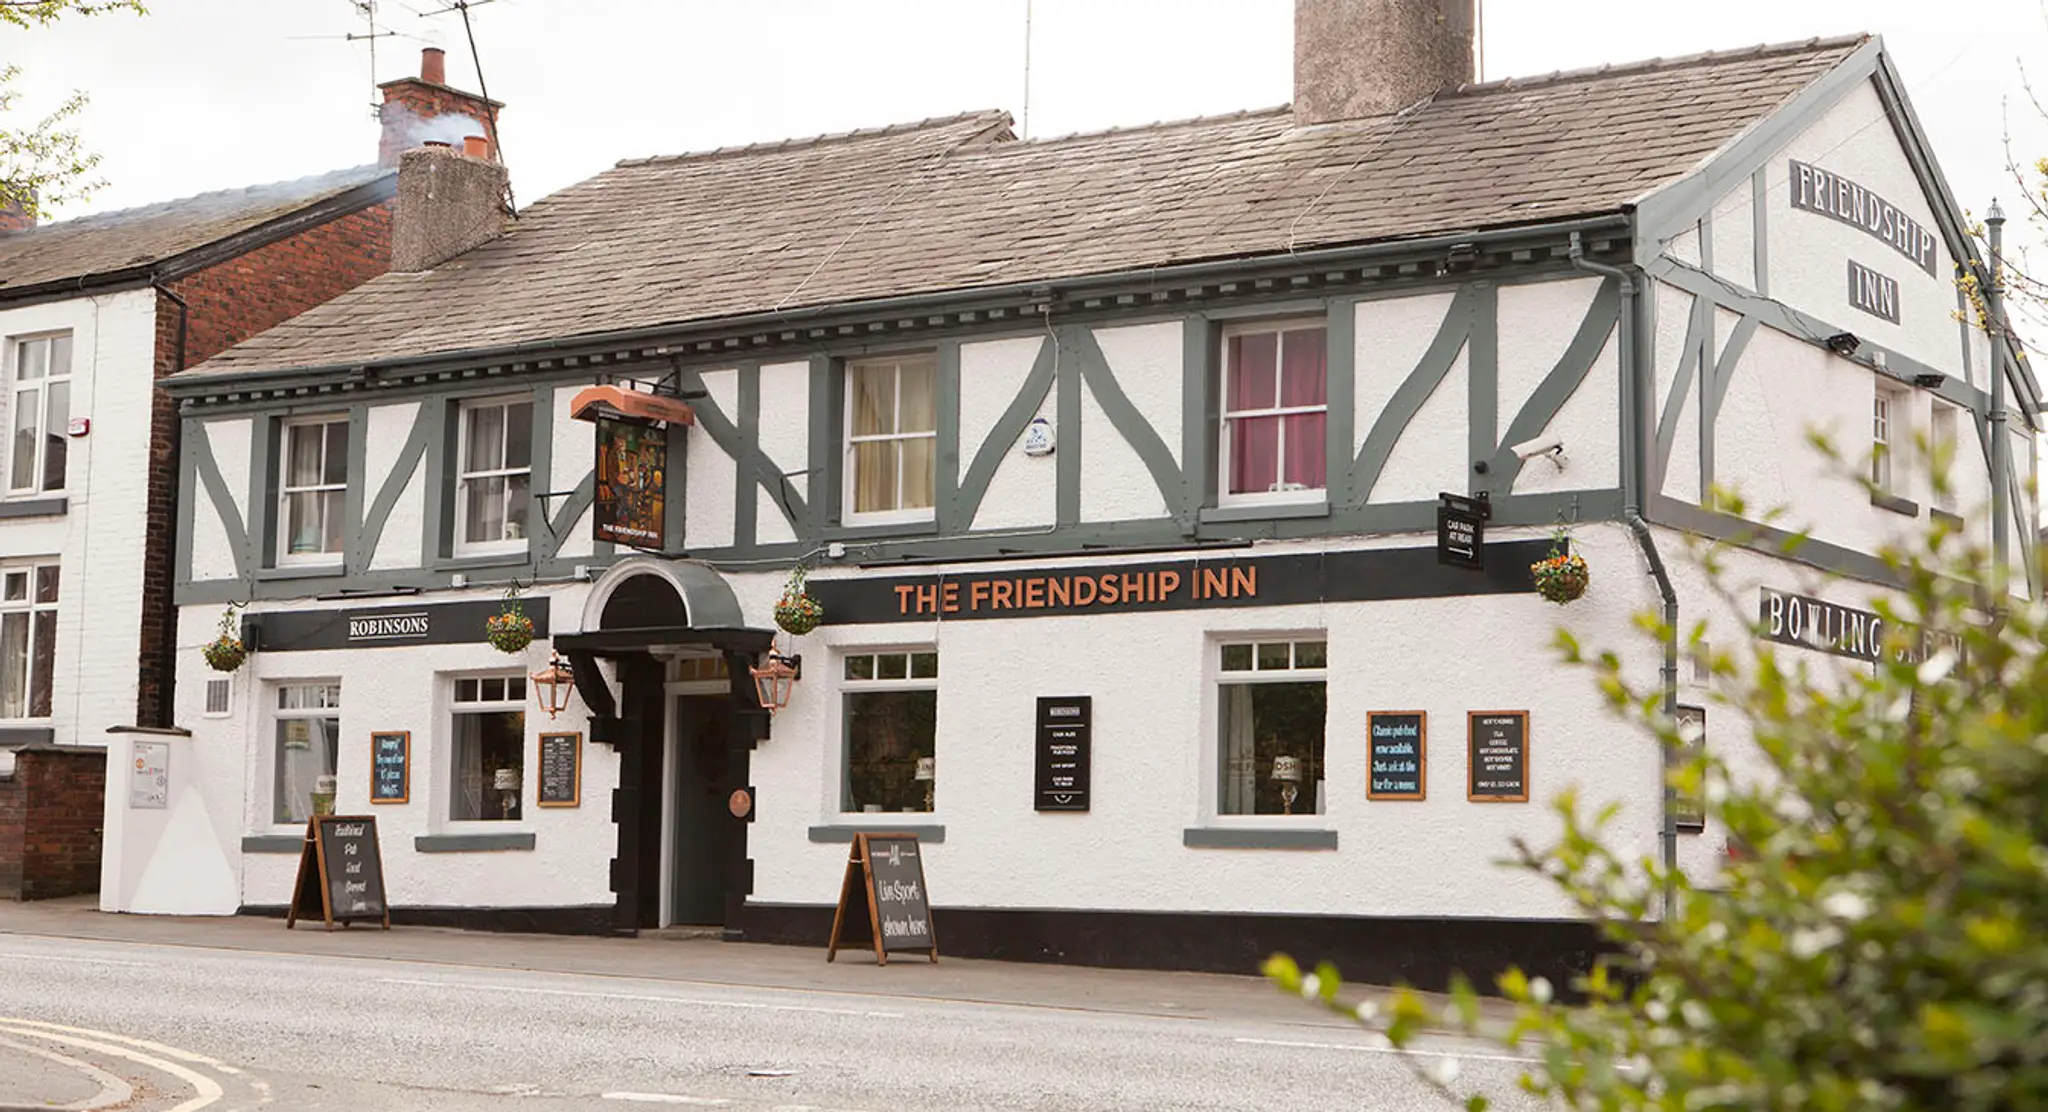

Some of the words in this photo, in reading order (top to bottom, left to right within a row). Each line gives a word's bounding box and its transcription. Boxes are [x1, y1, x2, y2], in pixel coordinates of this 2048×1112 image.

[1798, 163, 1932, 268] FRIENDSHIP
[1854, 265, 1894, 319] INN
[602, 523, 614, 533] THE
[614, 525, 646, 538] FRIENDSHIP
[1446, 519, 1459, 530] CAR
[894, 582, 960, 615] THE
[971, 569, 1181, 611] FRIENDSHIP
[1191, 565, 1257, 600] INN
[349, 616, 429, 637] ROBINSONS
[344, 842, 358, 856] Pub
